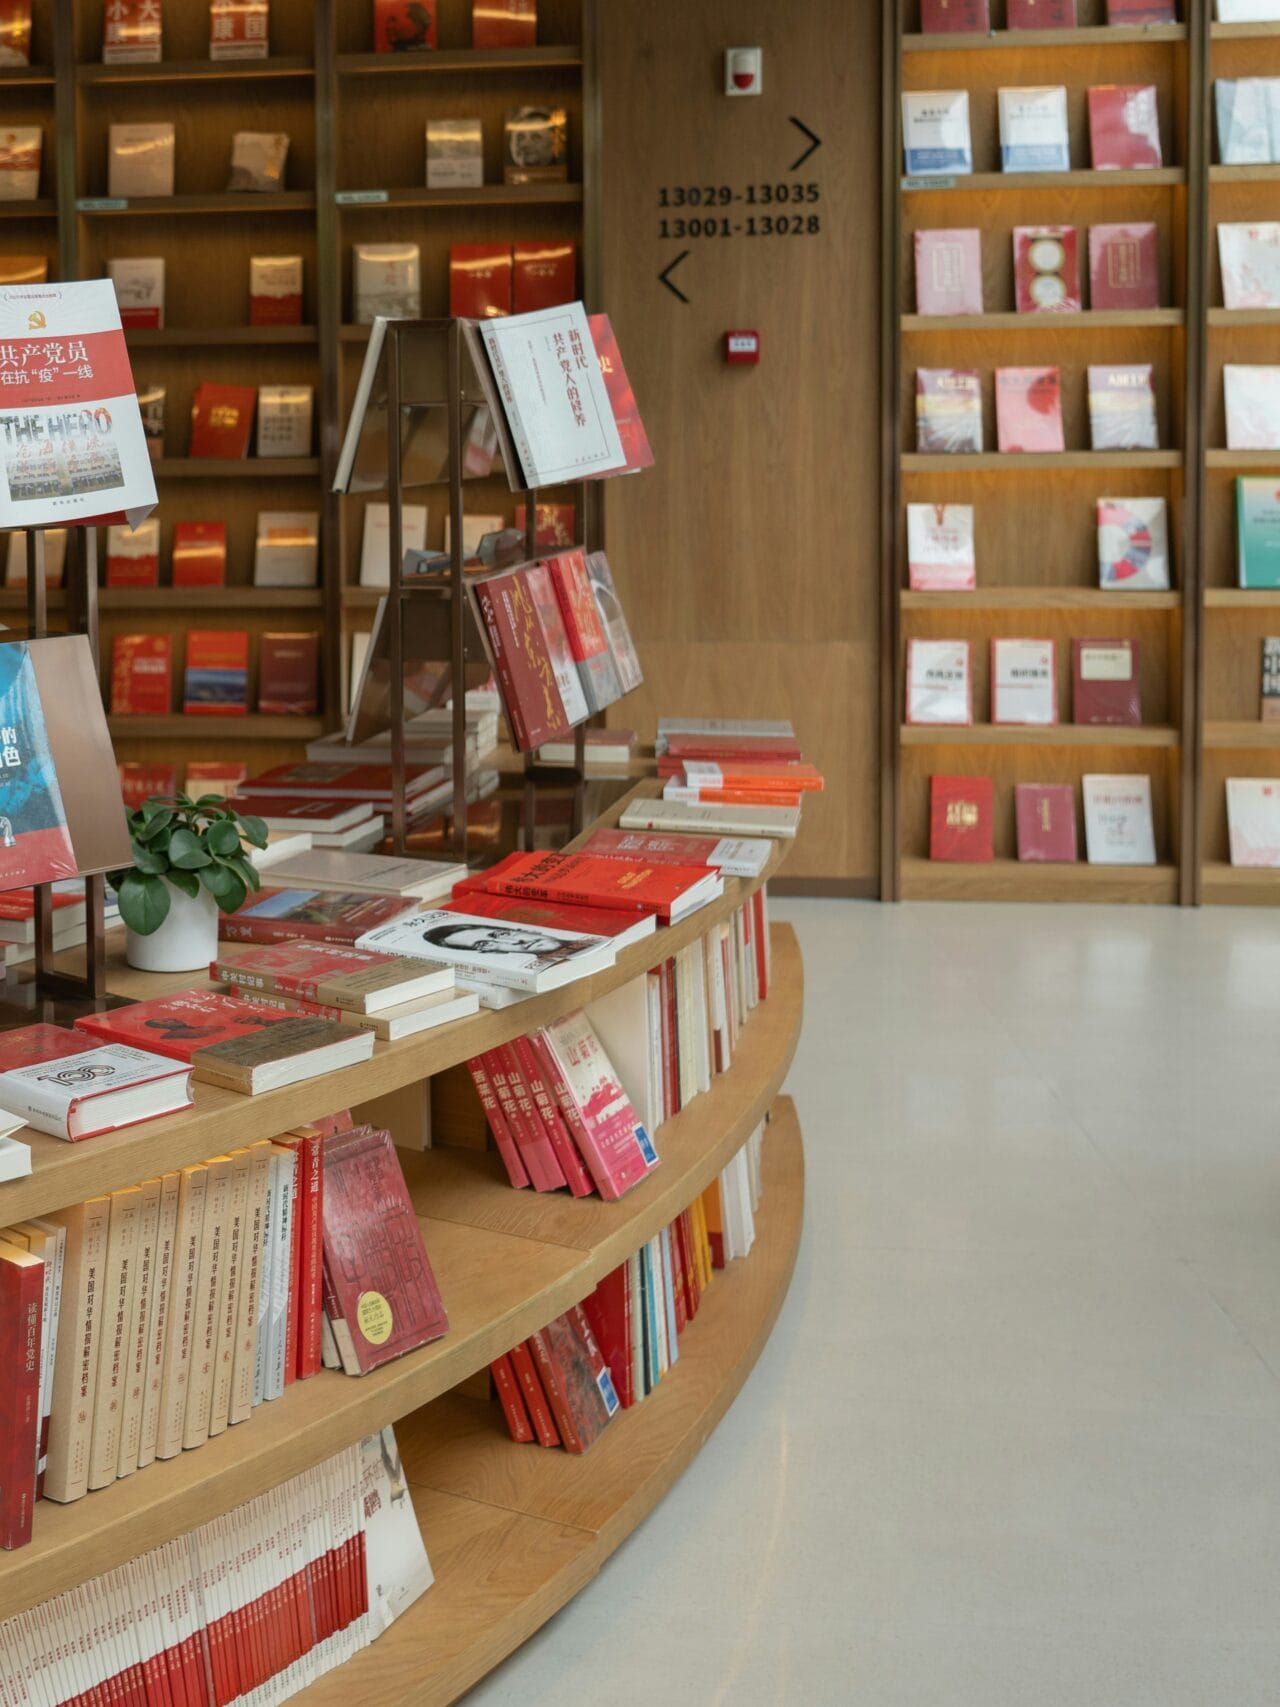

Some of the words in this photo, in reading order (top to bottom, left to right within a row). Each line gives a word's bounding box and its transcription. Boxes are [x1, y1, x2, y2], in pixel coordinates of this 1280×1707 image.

[658, 184, 820, 207] 13029-13035
[658, 215, 820, 238] 13001-13028
[568, 329, 589, 369] 新时代
[552, 332, 587, 427] 共产党人的修养
[48, 407, 112, 437] HERO
[25, 1303, 38, 1371] 读懂百年党史
